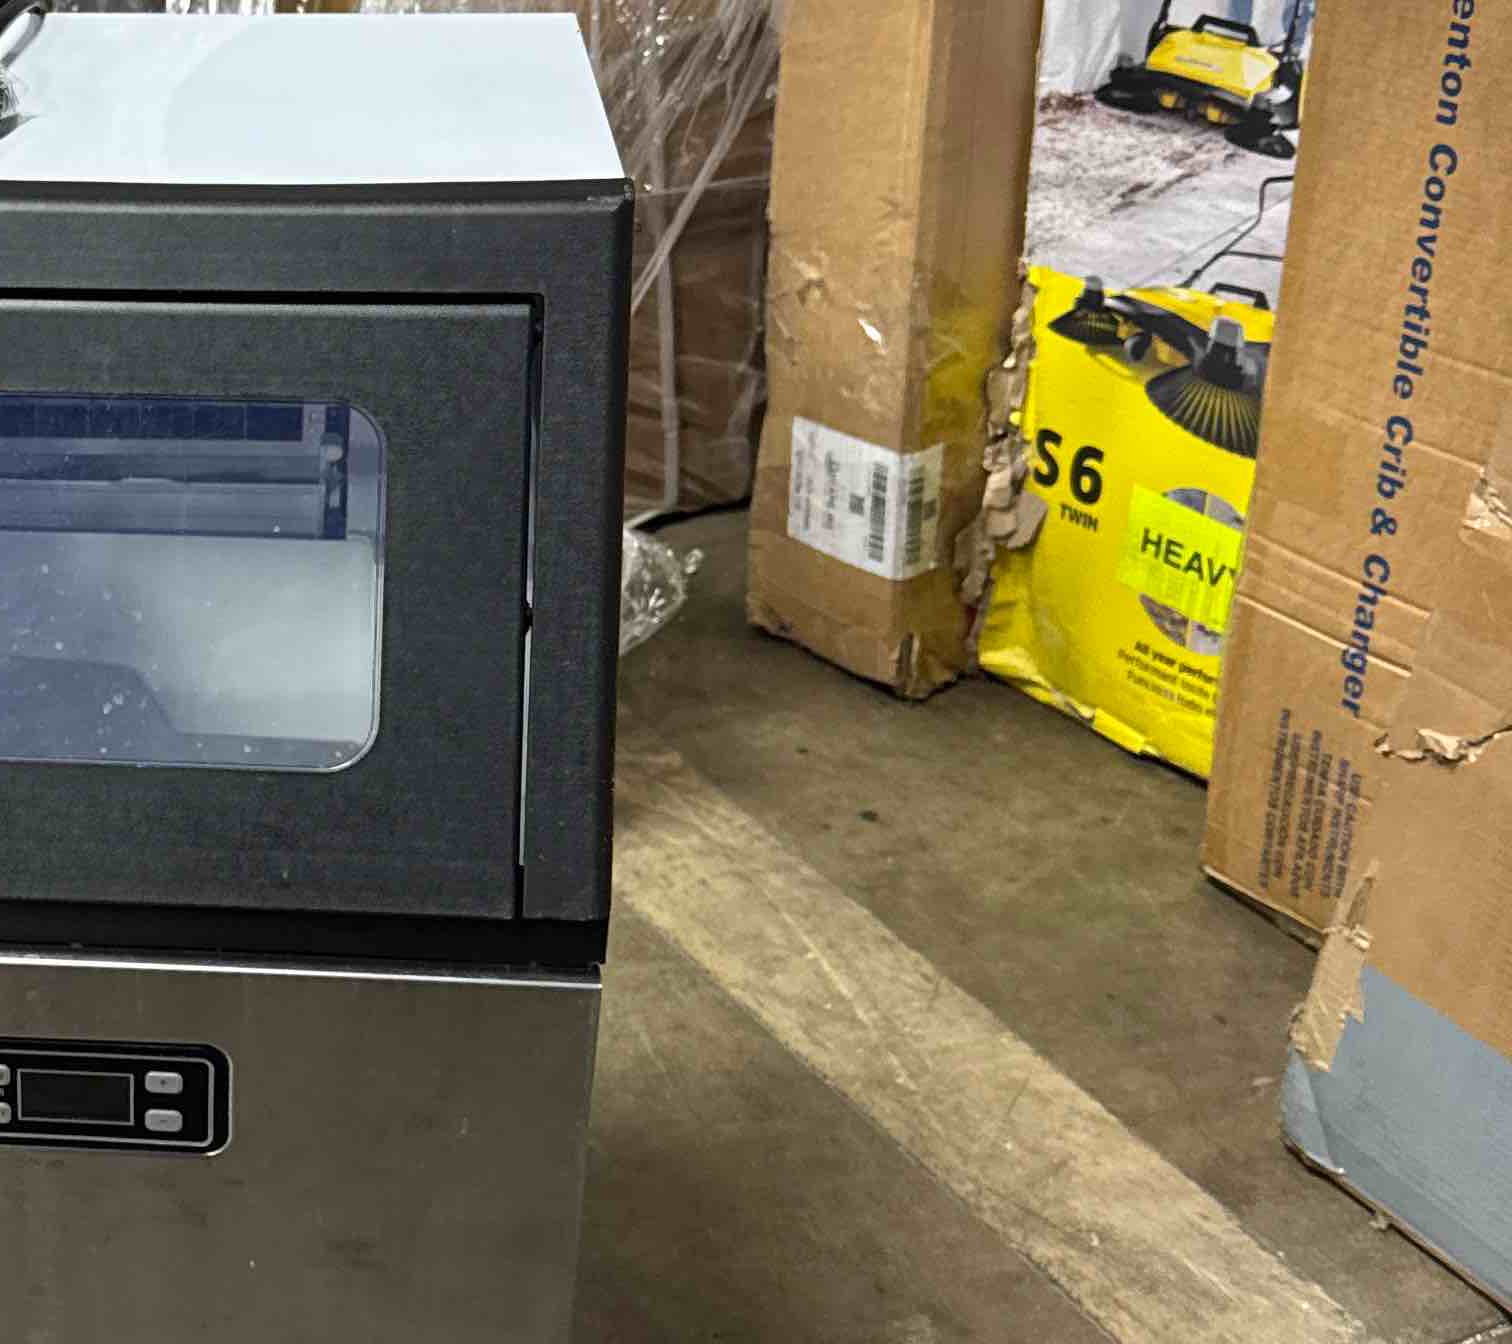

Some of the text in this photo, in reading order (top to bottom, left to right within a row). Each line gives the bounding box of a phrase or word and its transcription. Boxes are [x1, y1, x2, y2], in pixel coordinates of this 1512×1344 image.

[1391, 142, 1459, 401] Convertible
[1375, 415, 1413, 500] Crib
[1059, 503, 1100, 533] TWIN
[1369, 507, 1397, 537] &
[1338, 554, 1392, 720] Changer
